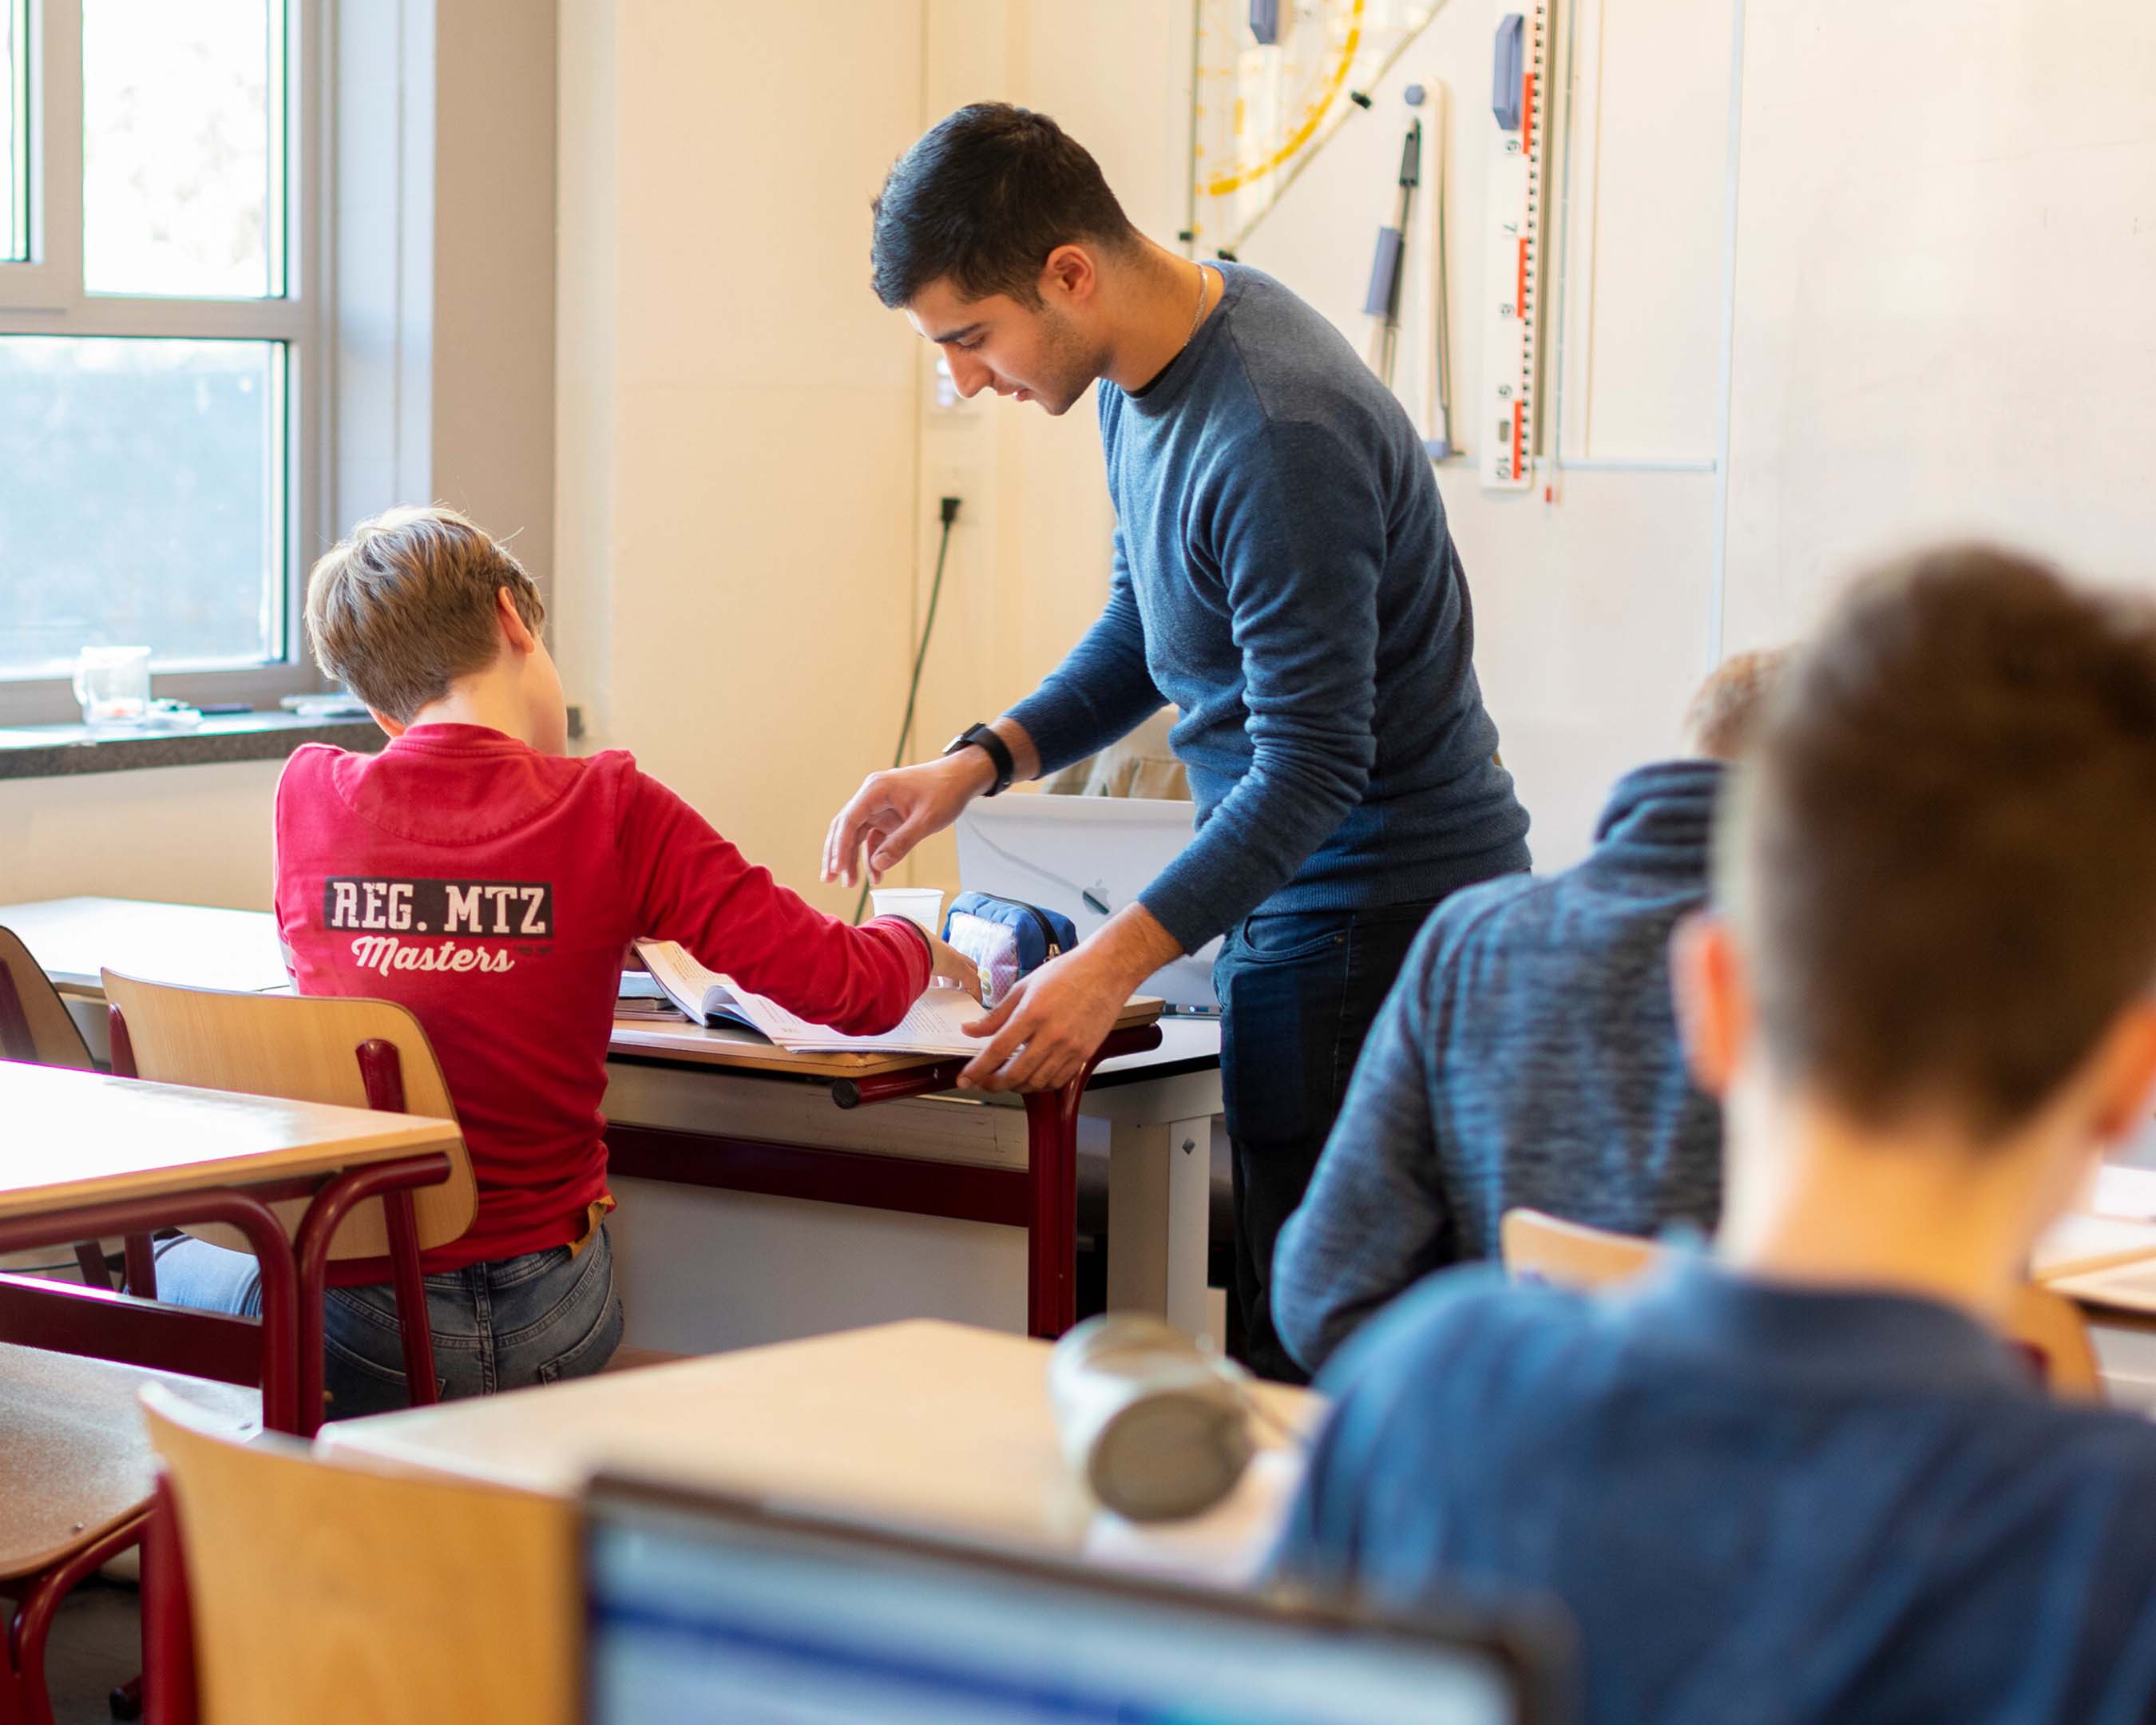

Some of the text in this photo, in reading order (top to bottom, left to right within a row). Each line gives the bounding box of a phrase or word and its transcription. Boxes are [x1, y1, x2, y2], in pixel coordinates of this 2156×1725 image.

[331, 882, 545, 934] REG. MTZ
[351, 936, 515, 977] Masters
